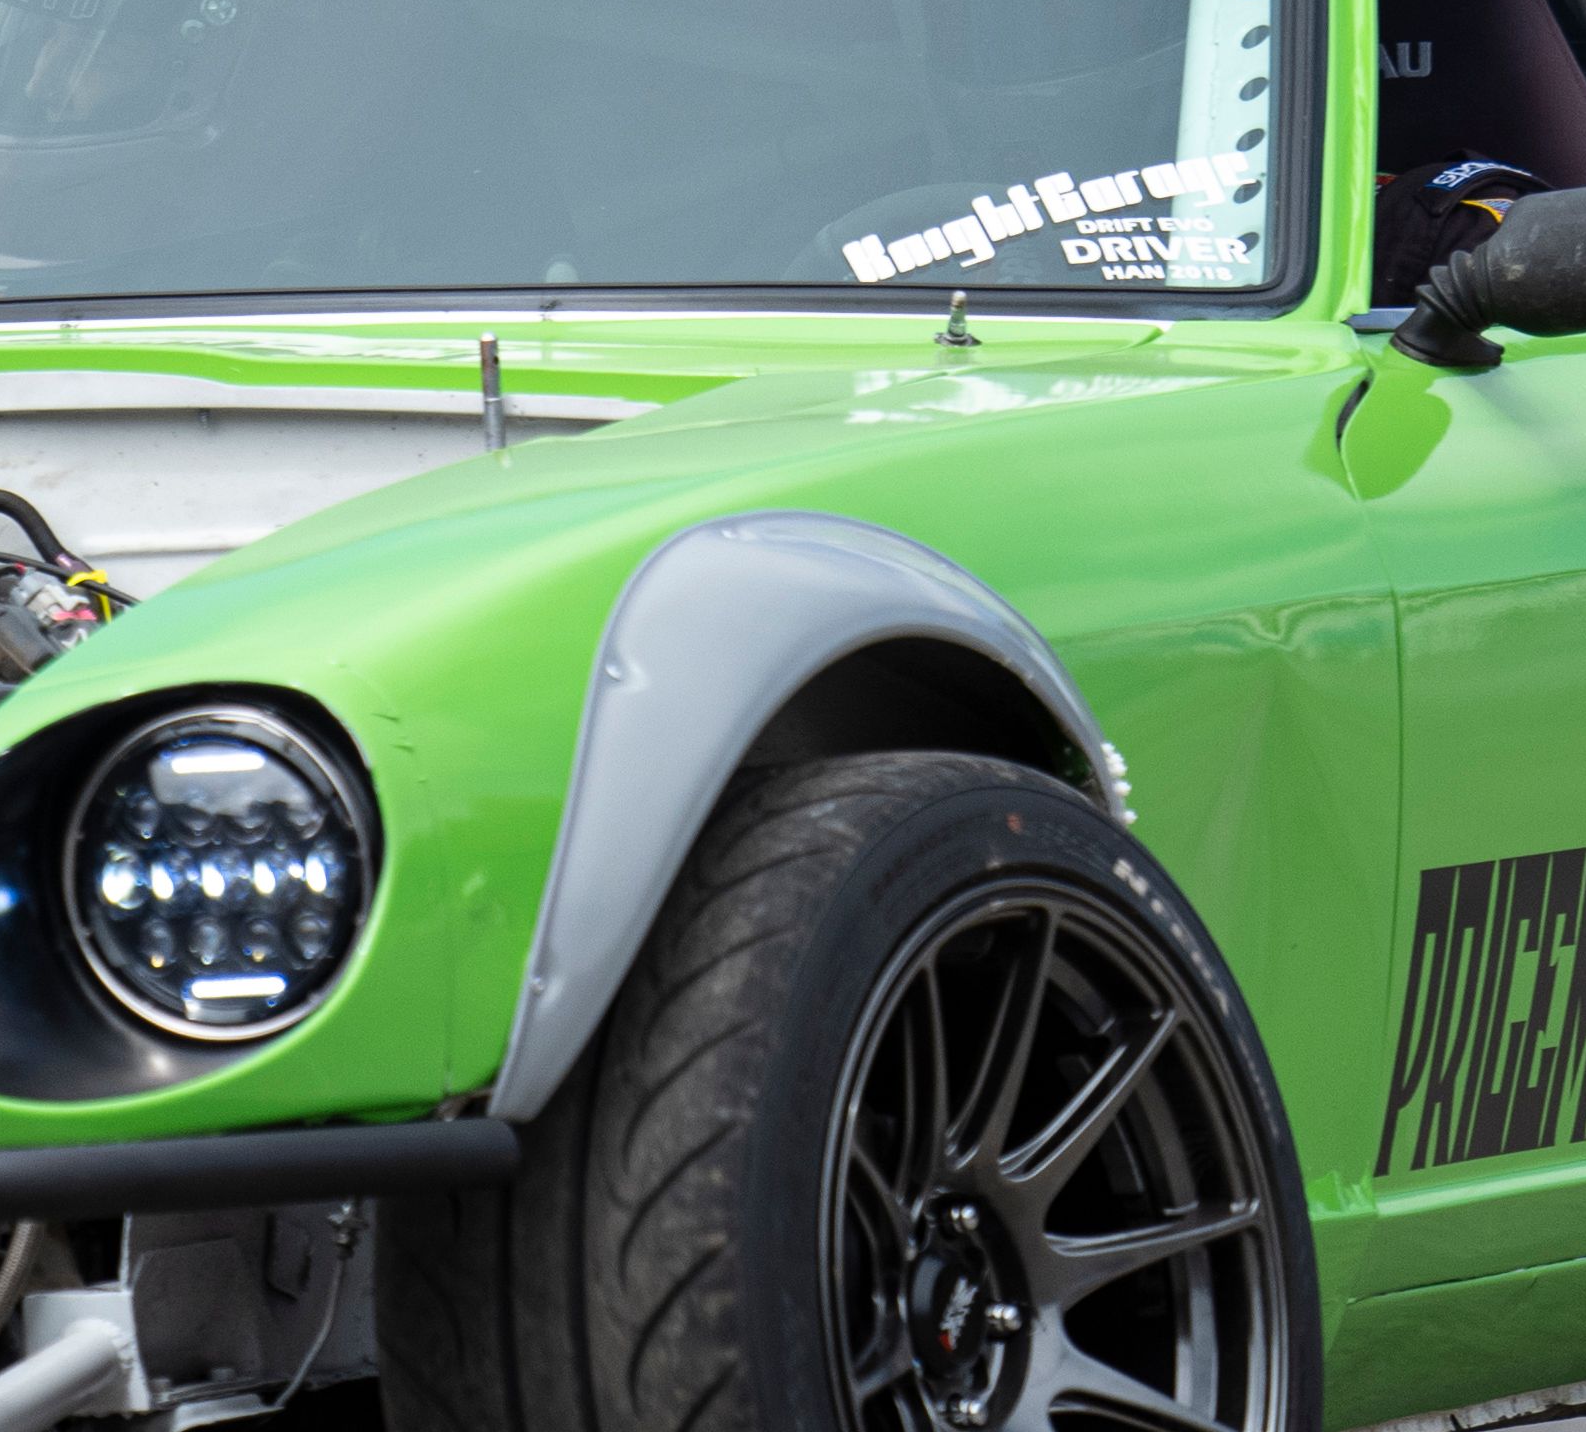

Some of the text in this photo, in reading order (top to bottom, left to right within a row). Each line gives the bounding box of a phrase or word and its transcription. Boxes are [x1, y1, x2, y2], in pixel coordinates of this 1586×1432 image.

[1076, 217, 1215, 235] DRIFT EVO
[1061, 235, 1251, 265] DRIVER
[1101, 264, 1234, 282] HAN 2018
